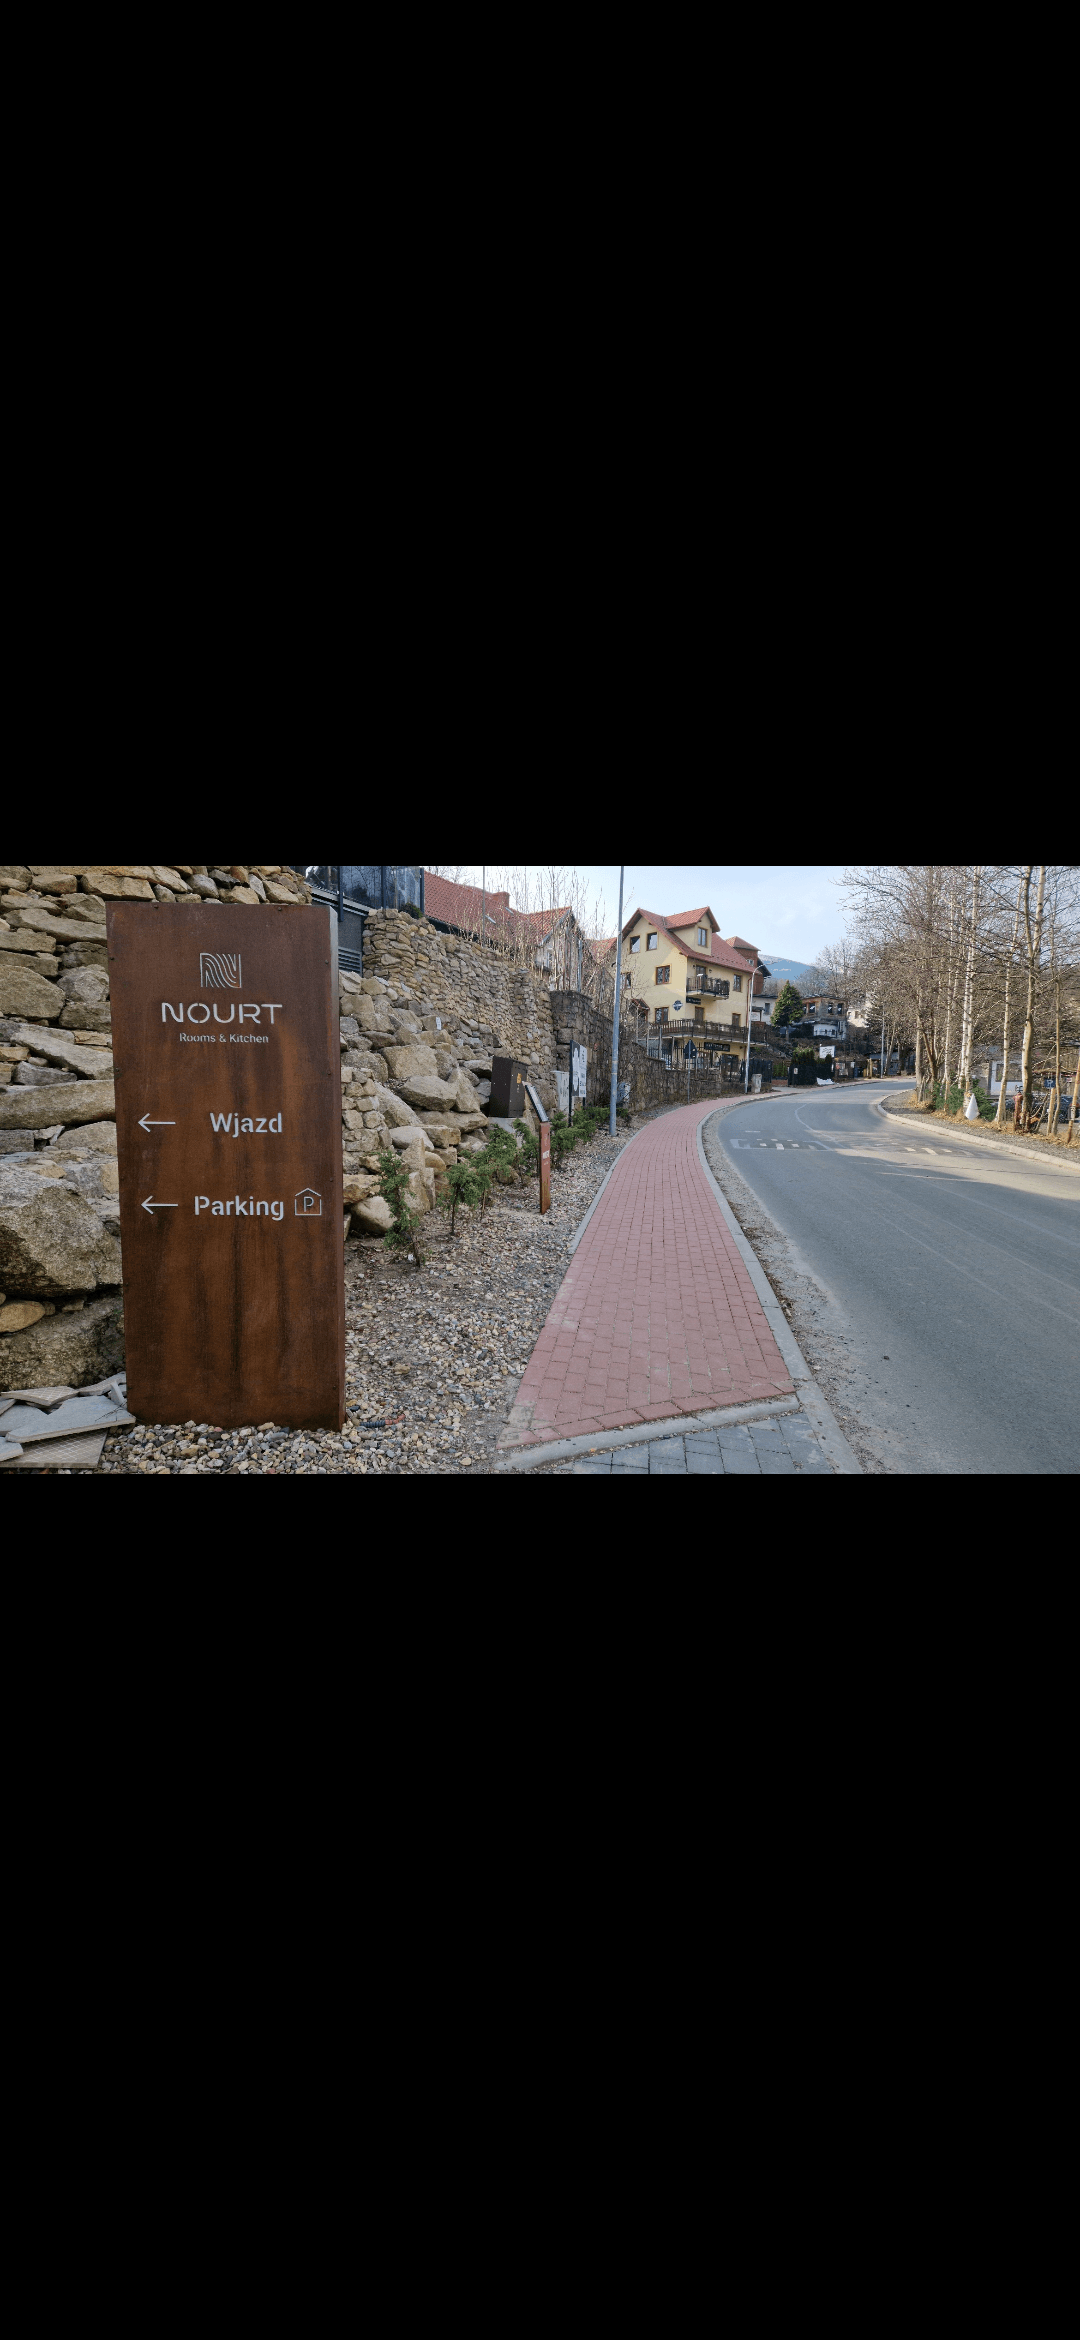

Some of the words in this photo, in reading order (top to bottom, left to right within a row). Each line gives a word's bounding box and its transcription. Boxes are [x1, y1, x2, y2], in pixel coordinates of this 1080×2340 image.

[161, 1002, 283, 1025] NOURT
[179, 1032, 216, 1043] Rooms
[219, 1033, 227, 1043] &
[229, 1033, 269, 1044] Kitchen
[210, 1112, 283, 1138] Wjazd
[194, 1195, 284, 1221] Parking
[303, 1196, 314, 1212] P
